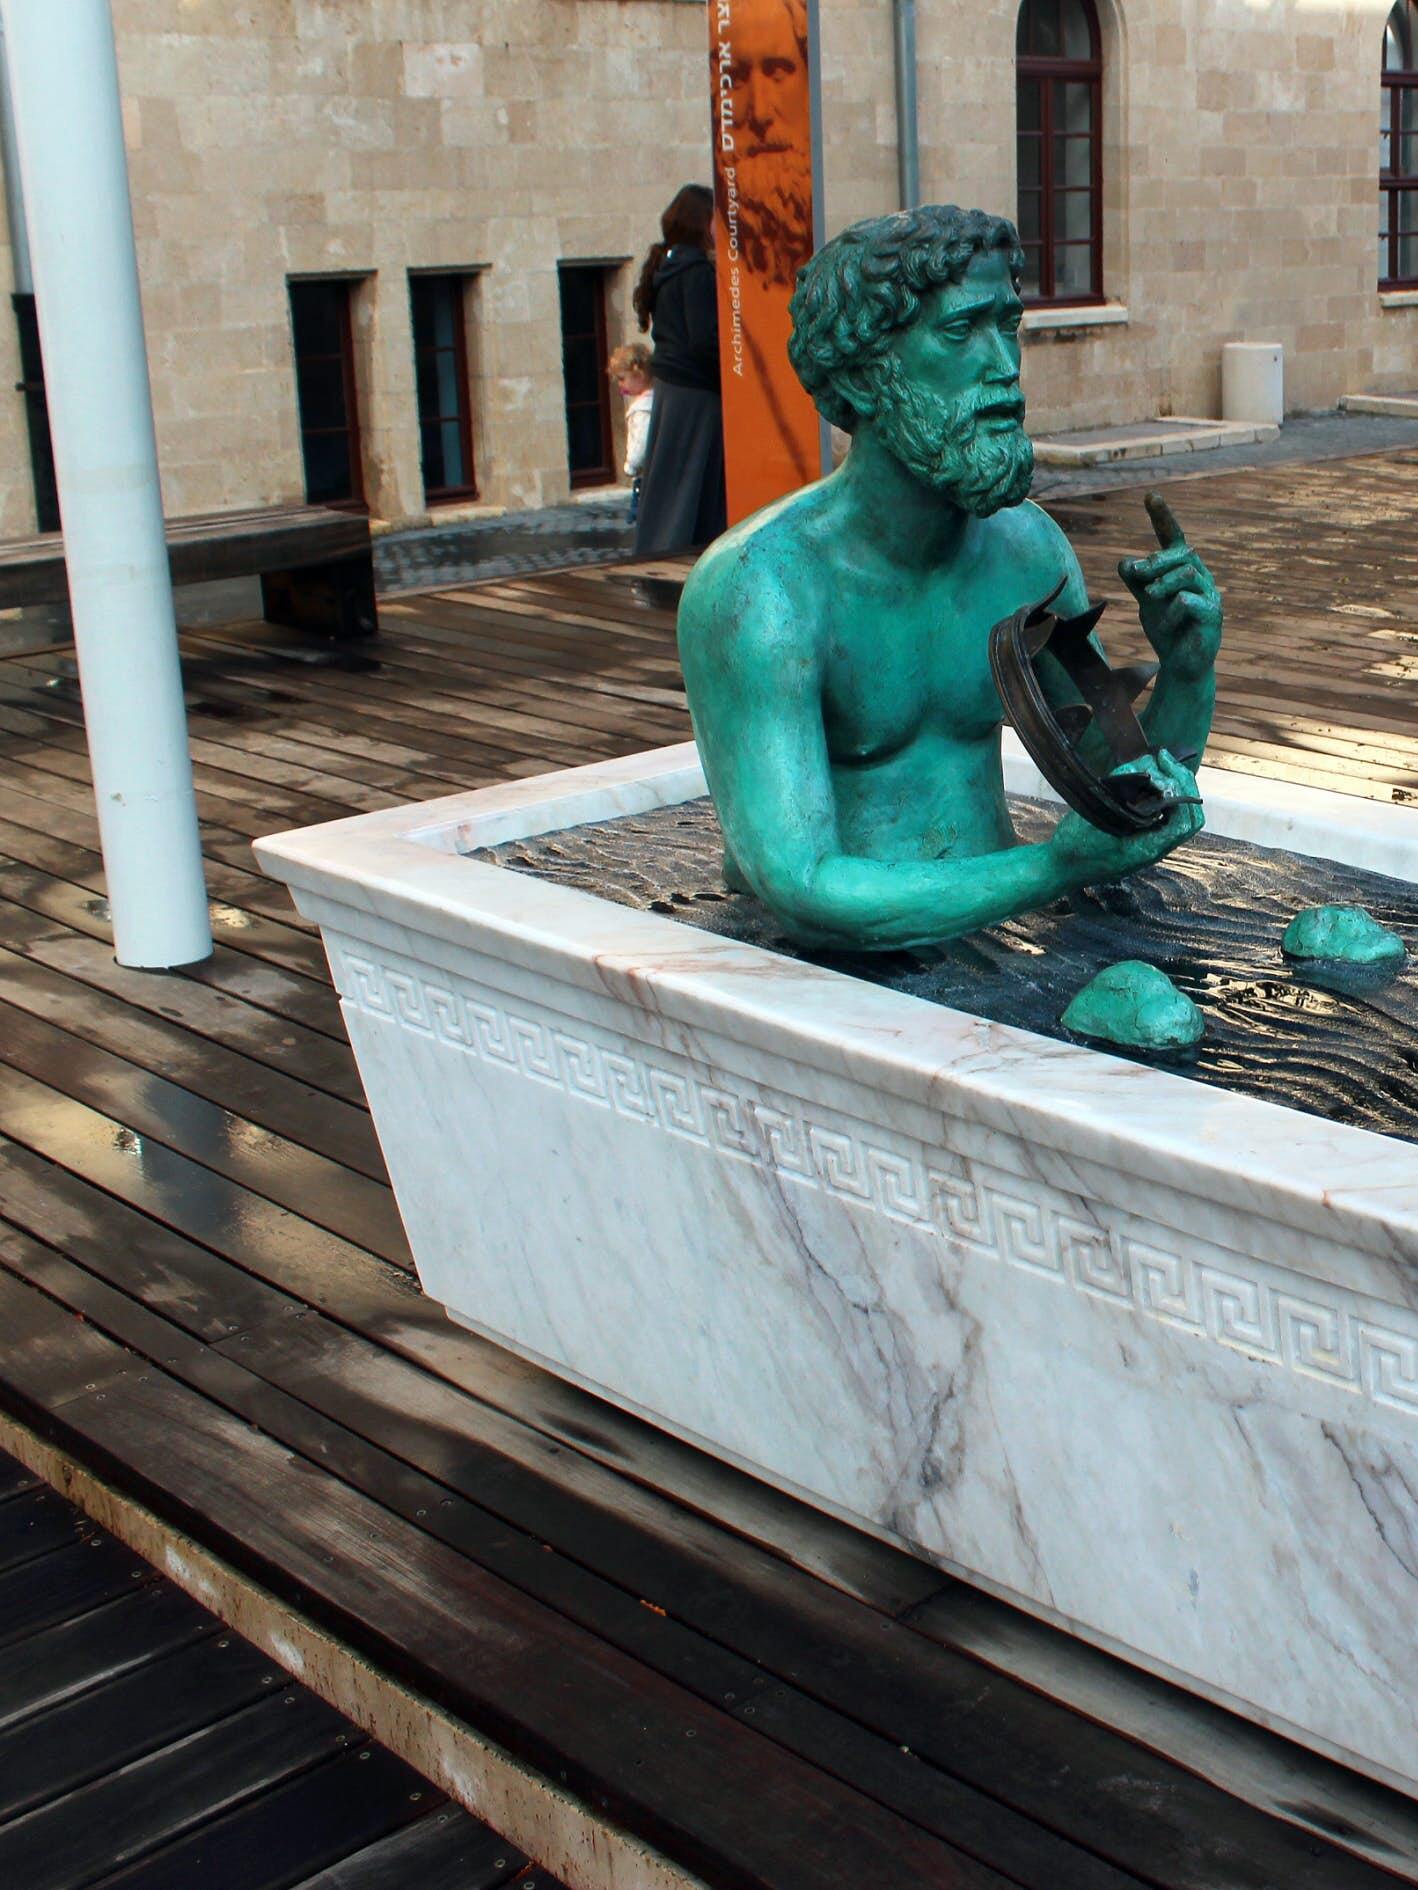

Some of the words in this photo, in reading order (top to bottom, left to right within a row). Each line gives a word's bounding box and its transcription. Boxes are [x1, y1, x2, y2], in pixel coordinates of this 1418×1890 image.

[717, 0, 730, 34] צר
[718, 41, 734, 152] ארכימדס
[724, 167, 740, 261] Courtyard
[729, 267, 743, 376] Archimedes
